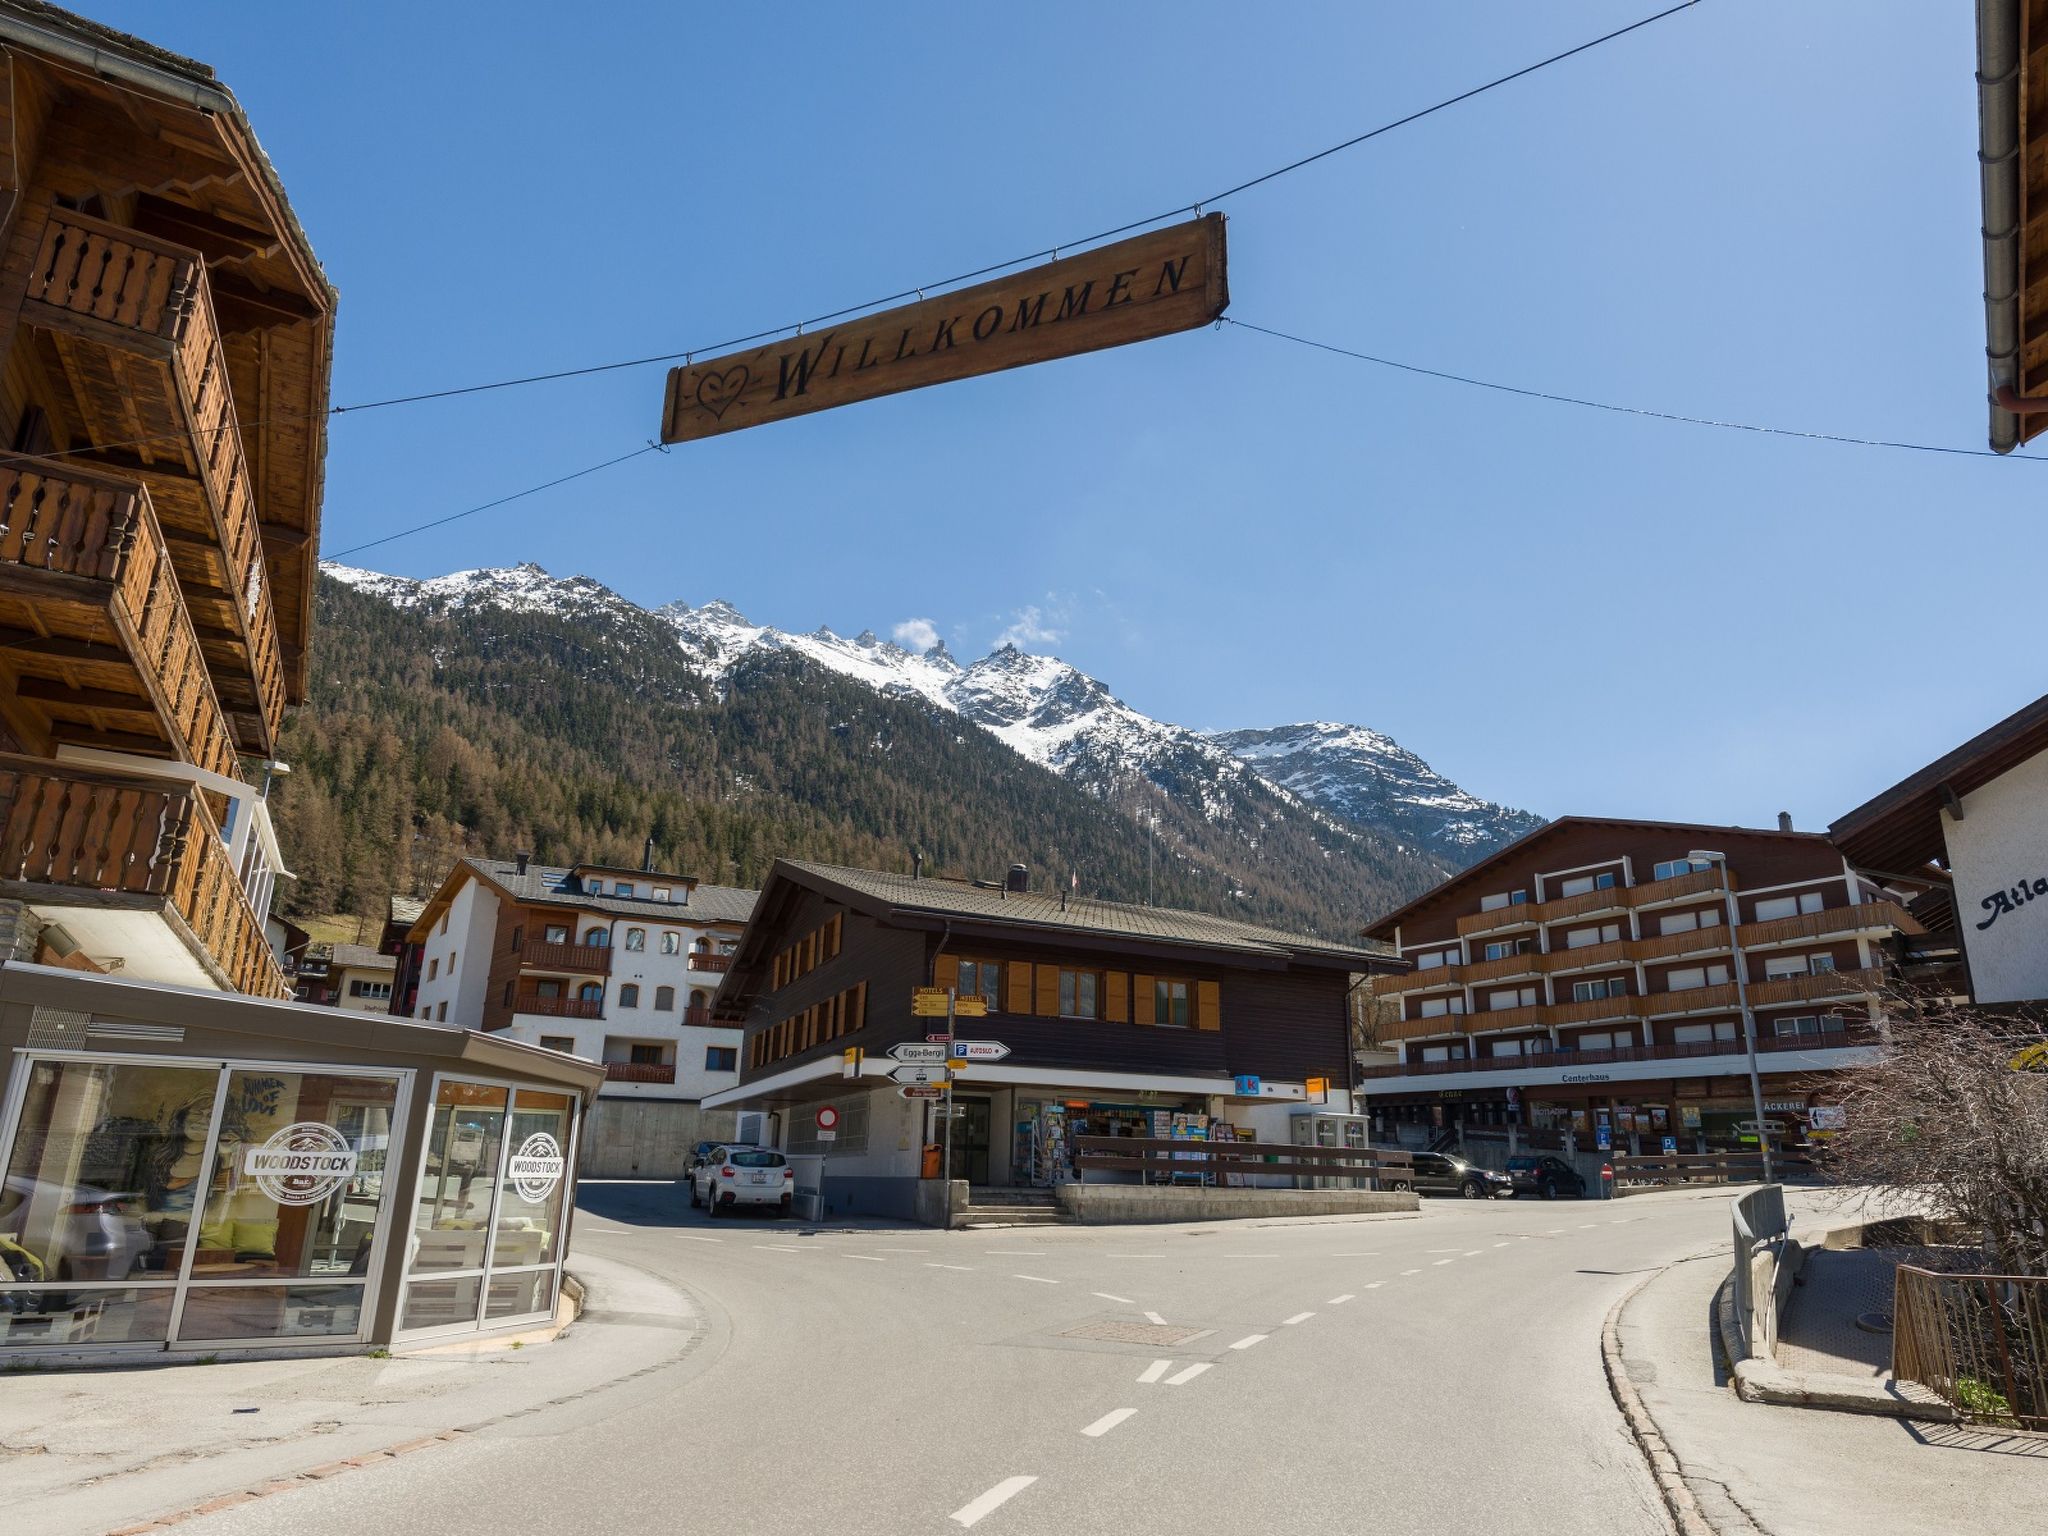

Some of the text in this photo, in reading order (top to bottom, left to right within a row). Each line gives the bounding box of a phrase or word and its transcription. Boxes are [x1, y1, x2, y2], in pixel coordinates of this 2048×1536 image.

[772, 255, 1196, 401] WILLKOMMEN
[1976, 877, 2048, 931] Atla
[920, 986, 943, 994] HOTELS
[1562, 1074, 1610, 1083] Centerhaus
[263, 1090, 280, 1103] OF
[242, 1095, 278, 1116] LOVE
[1764, 1101, 1805, 1111] ÄCKEREI
[254, 1154, 352, 1172] WOODSTOCK
[514, 1160, 562, 1173] WOODSTOCK
